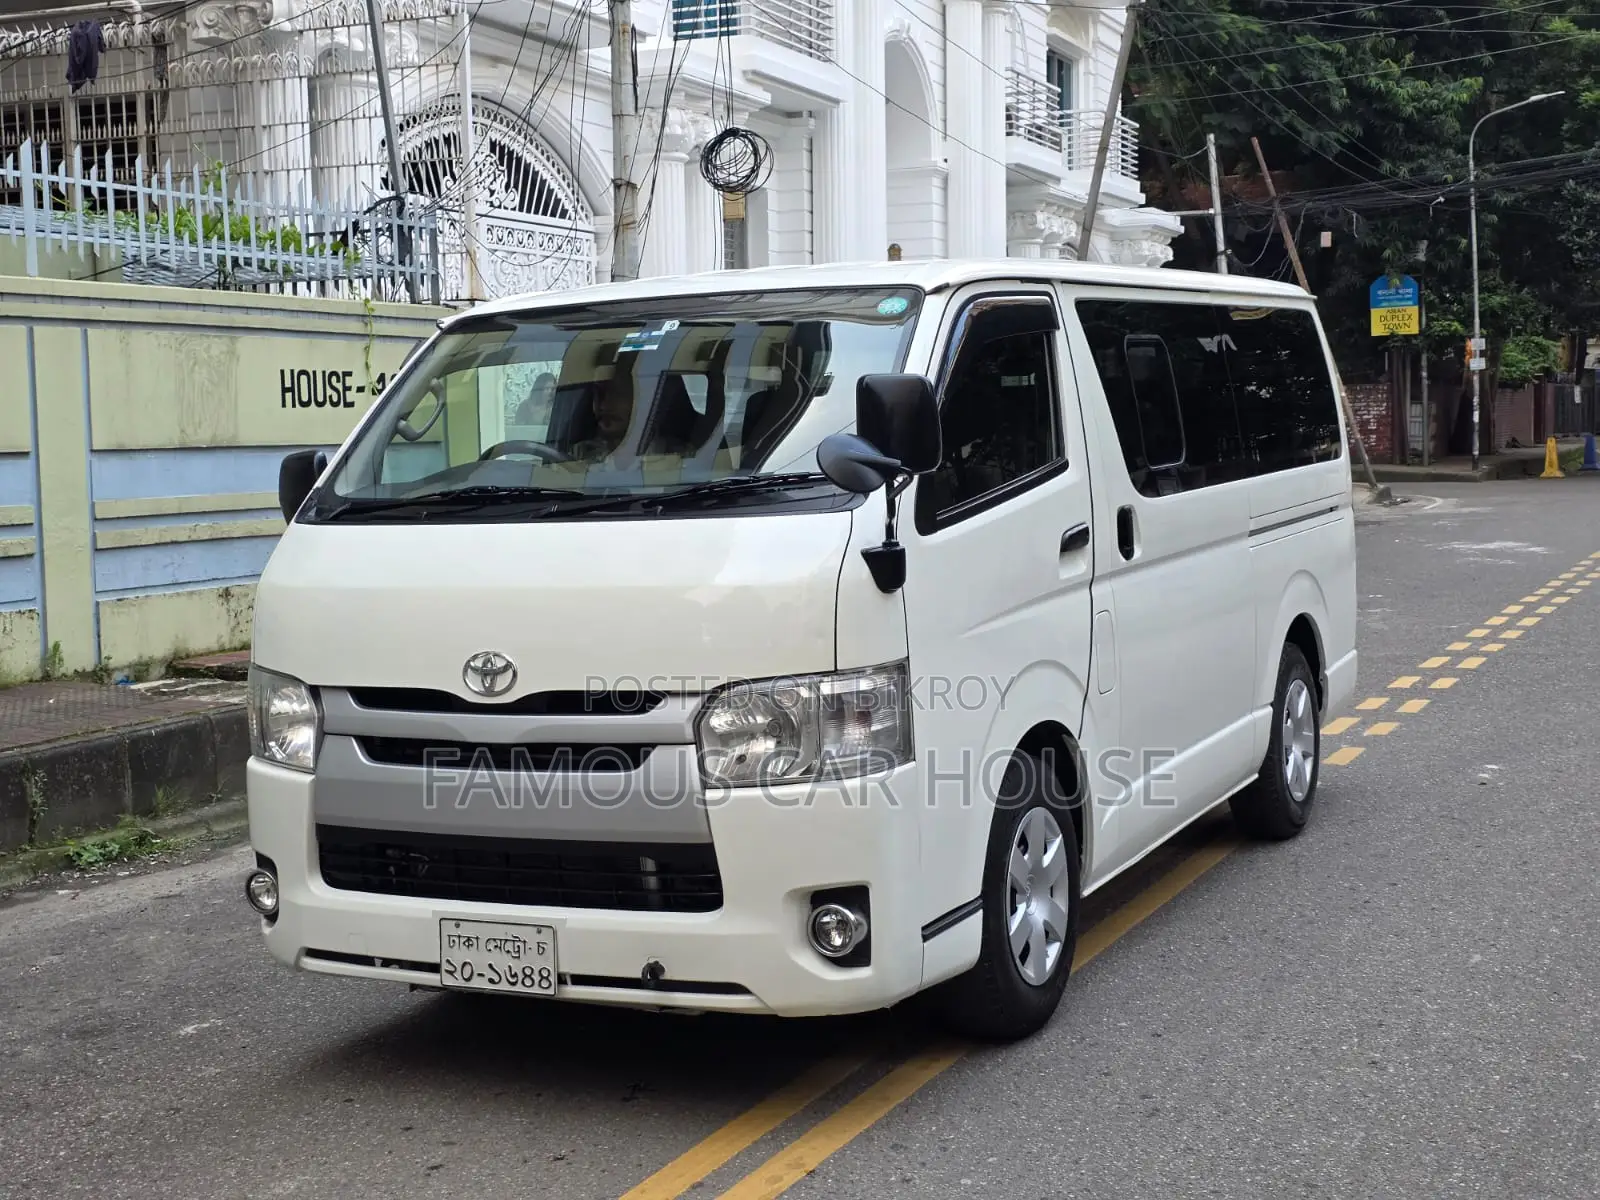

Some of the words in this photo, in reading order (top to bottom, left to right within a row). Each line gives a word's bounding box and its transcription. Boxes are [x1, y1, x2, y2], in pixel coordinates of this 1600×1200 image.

[1379, 313, 1413, 323] DUPLEX
[1382, 321, 1411, 331] TOWN
[447, 932, 480, 952] ঢাকা
[444, 958, 553, 990] ২০-১৬৪৪
